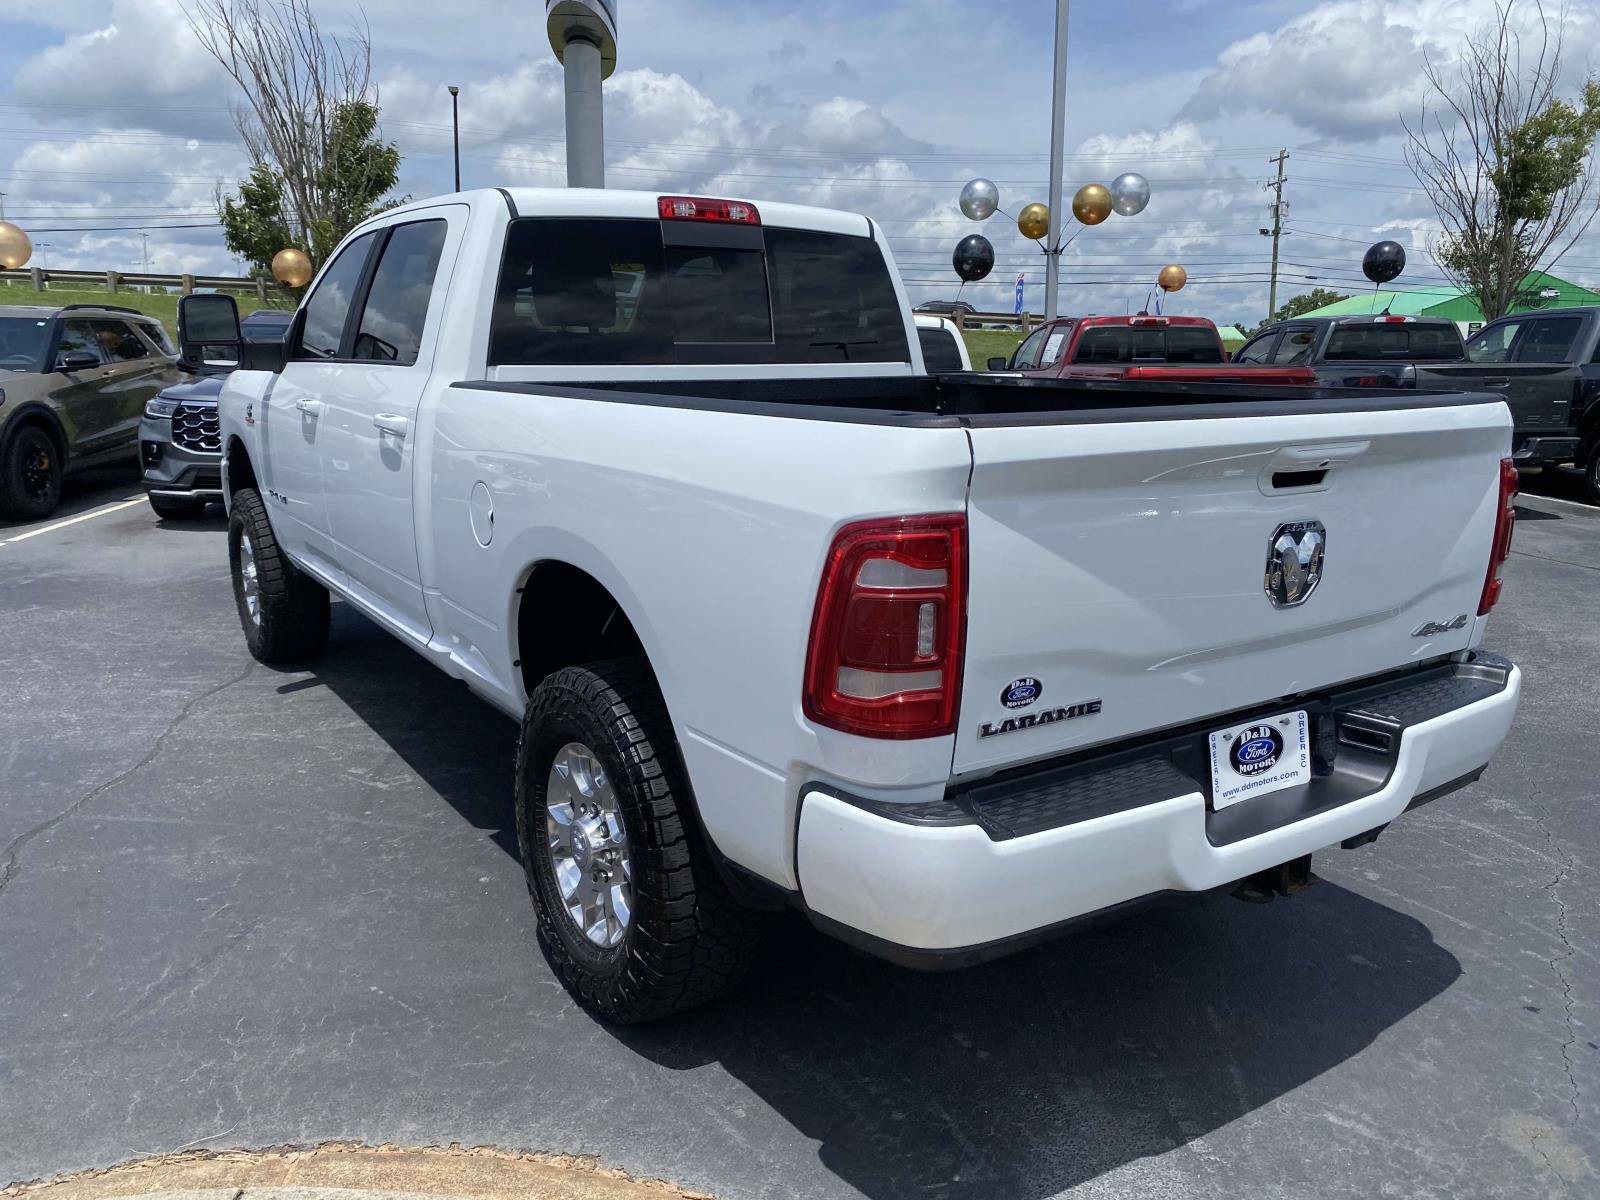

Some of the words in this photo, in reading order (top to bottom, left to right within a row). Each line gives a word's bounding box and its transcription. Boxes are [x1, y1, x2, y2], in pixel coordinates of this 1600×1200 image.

[1011, 678, 1034, 690] D&D
[1006, 697, 1036, 708] MOTORS
[977, 698, 1102, 738] LARAMIE
[1240, 726, 1271, 745] D&D
[1298, 713, 1306, 750] GREER
[1210, 734, 1219, 774] GREER
[1245, 742, 1268, 760] Ford
[1300, 753, 1307, 768] SC
[1240, 755, 1276, 774] MOTORS
[1222, 770, 1298, 797] www.ddmotors.com
